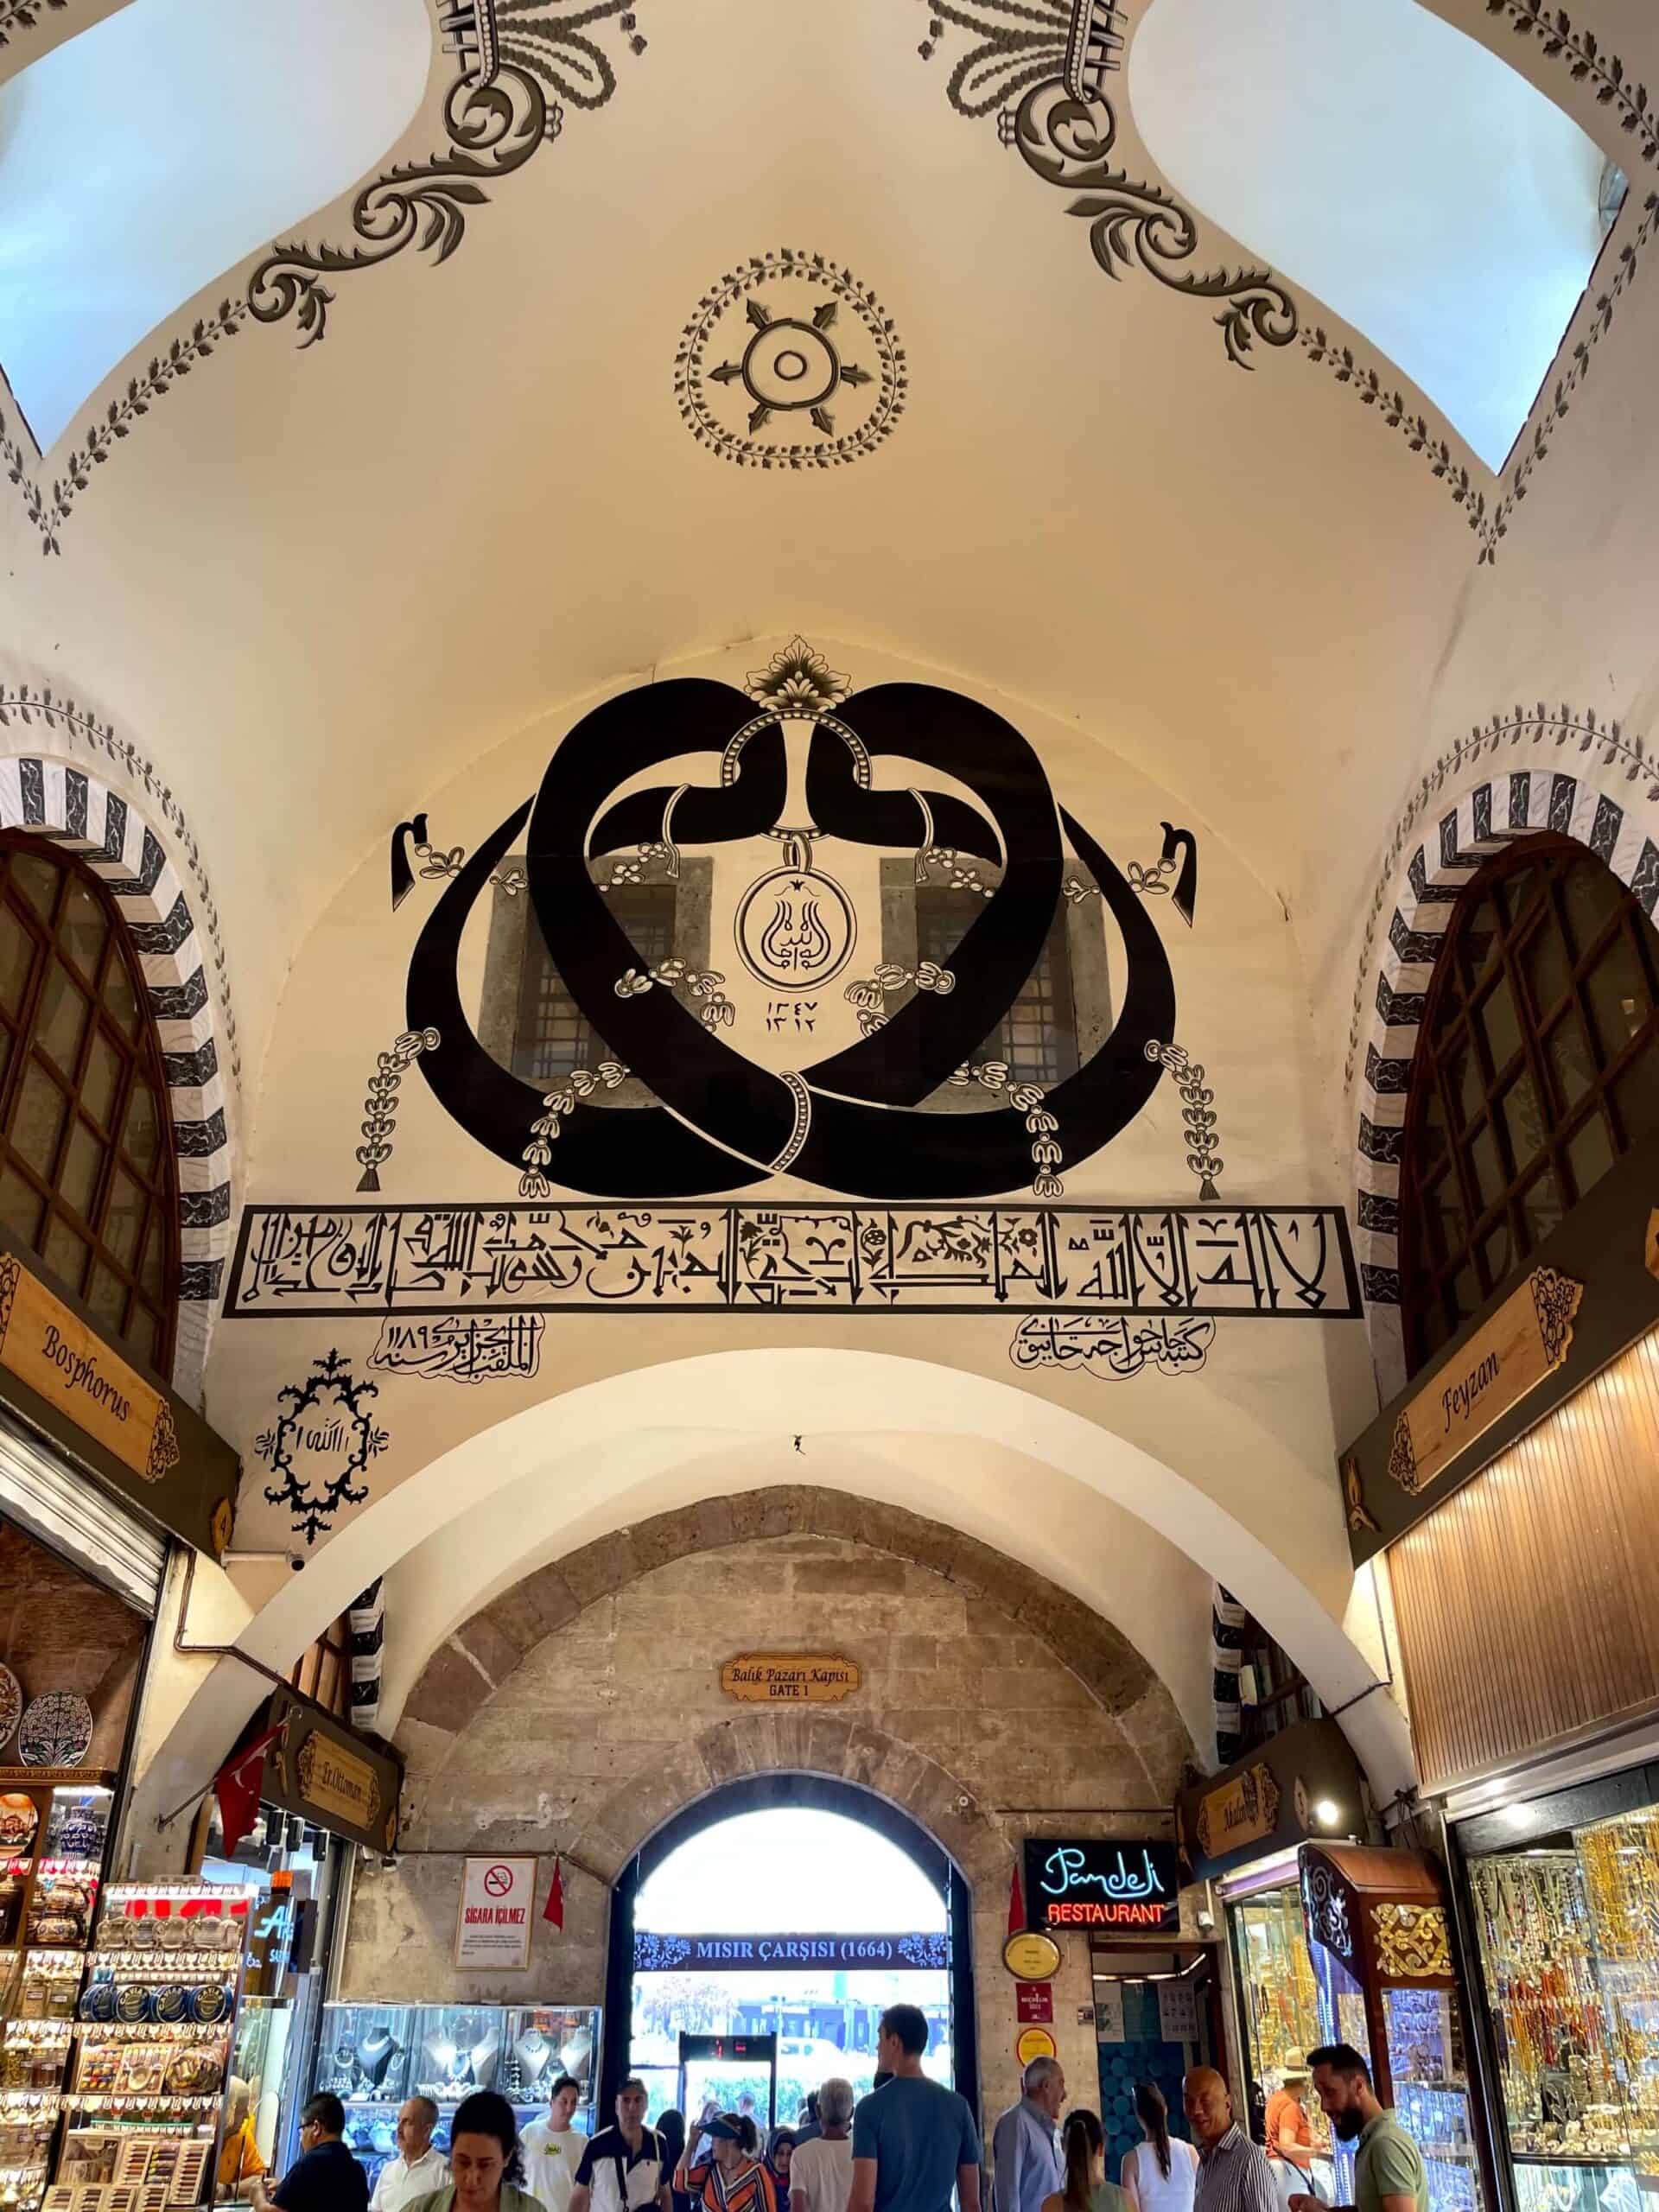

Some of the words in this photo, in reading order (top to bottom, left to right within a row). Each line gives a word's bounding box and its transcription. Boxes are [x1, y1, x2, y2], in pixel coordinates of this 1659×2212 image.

[42, 1325, 131, 1422] Bosphorus
[1441, 1351, 1500, 1433] Feyzan
[732, 1668, 762, 1682] Balık
[766, 1668, 806, 1682] Pazarı
[810, 1668, 849, 1688] Kapısı
[769, 1684, 799, 1696] GATE
[804, 1684, 809, 1696] 1
[1039, 1847, 1166, 1898] Pandeli
[1047, 1904, 1165, 1924] RESTAURANT
[696, 1942, 753, 1958] MISIR
[758, 1941, 836, 1961] ÇARŞISI
[840, 1941, 893, 1961] (1664)
